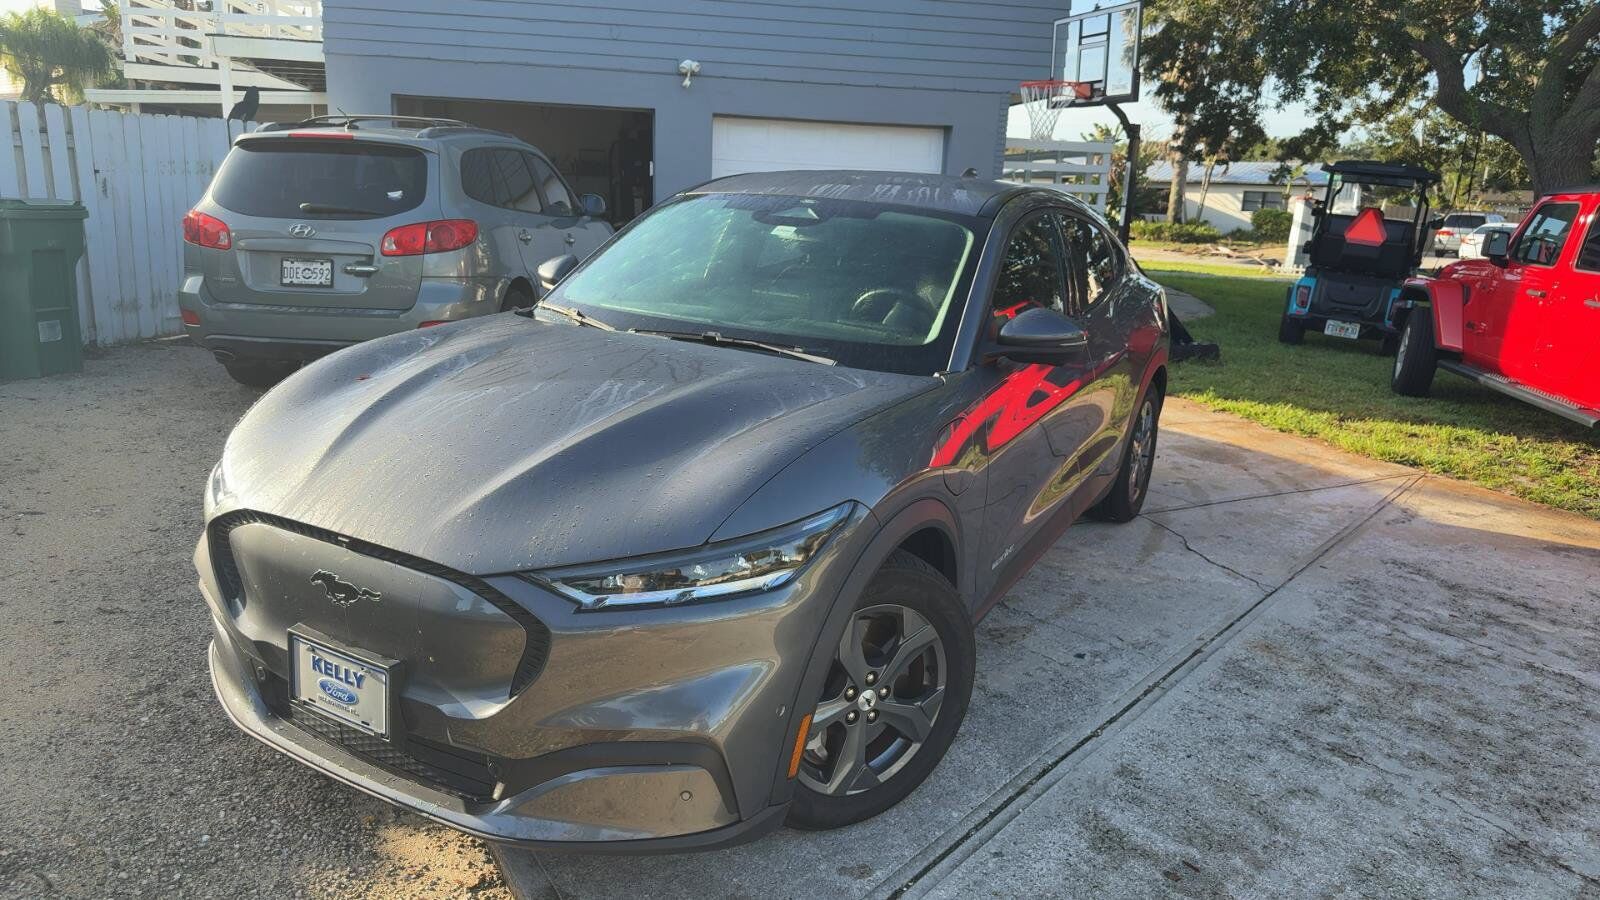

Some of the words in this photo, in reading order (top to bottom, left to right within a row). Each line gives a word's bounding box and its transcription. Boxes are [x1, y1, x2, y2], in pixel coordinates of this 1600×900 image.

[312, 267, 331, 281] 592
[311, 655, 366, 690] KELLY
[324, 681, 352, 702] Ford
